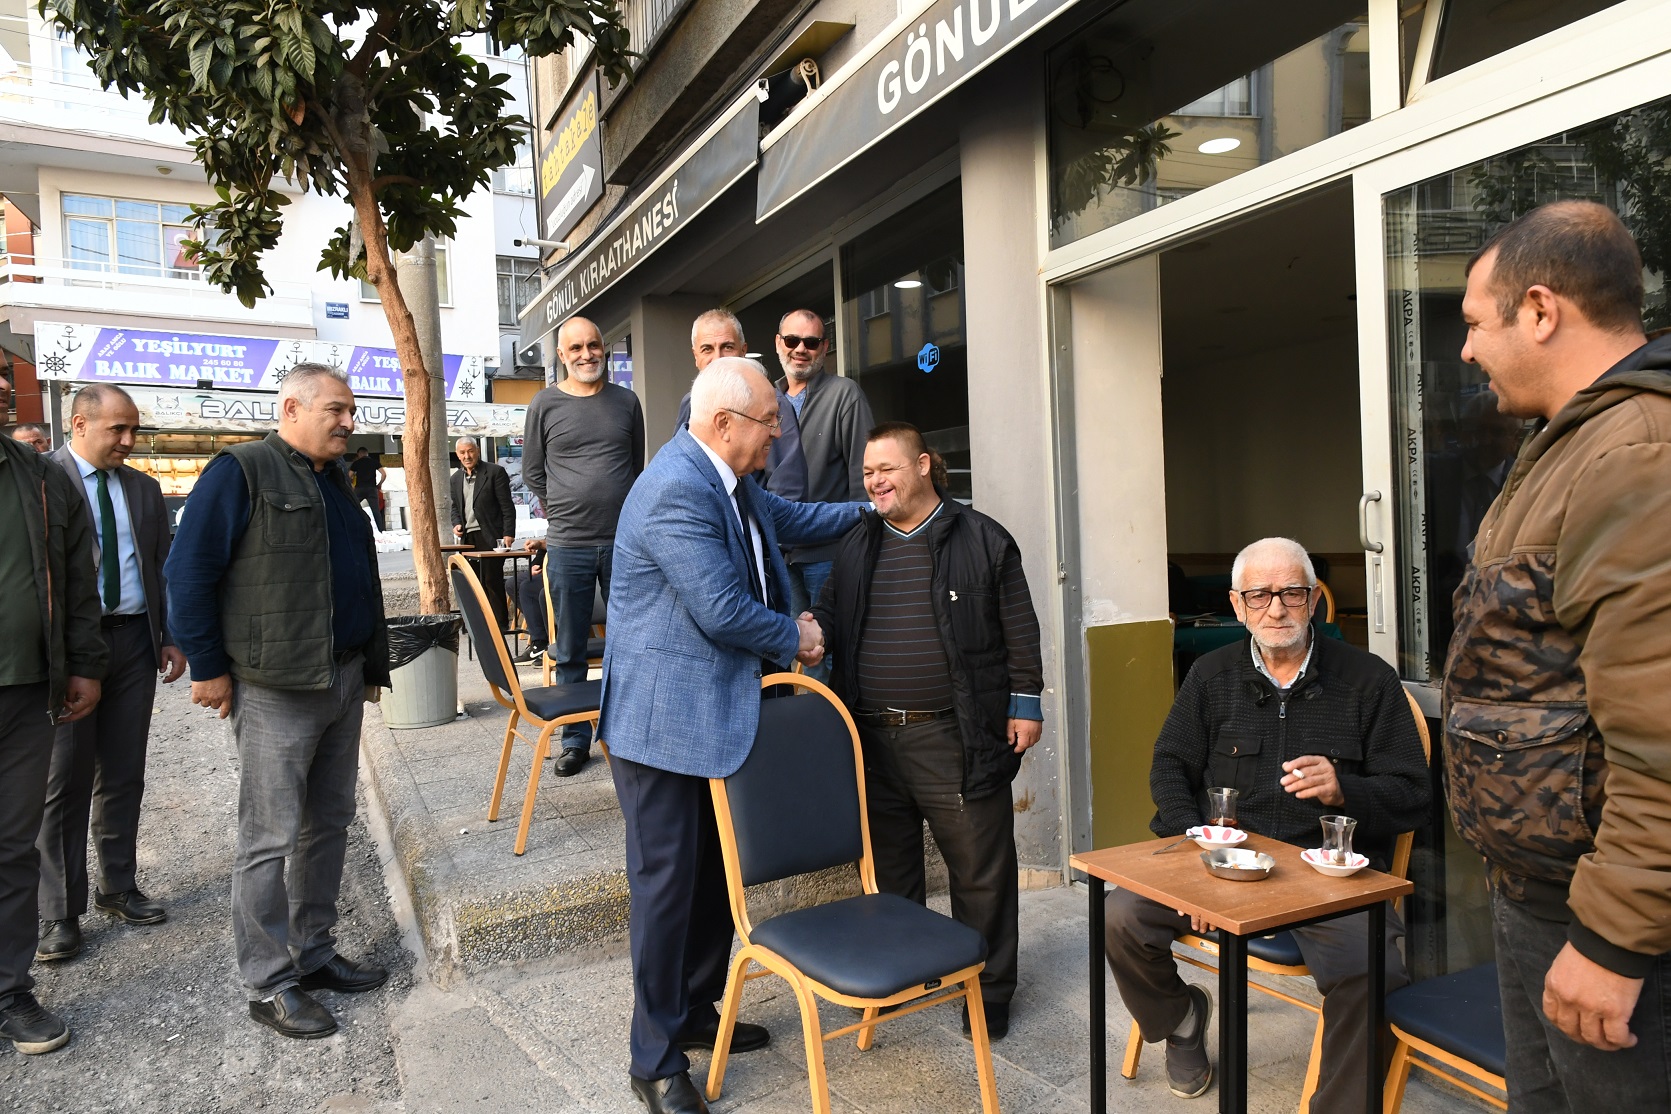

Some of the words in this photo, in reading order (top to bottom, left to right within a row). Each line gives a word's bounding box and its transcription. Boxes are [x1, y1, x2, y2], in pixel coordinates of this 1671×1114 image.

[546, 279, 578, 324] GÖNÜL
[579, 178, 679, 298] KIRAATHANESİ
[1402, 289, 1413, 327] AKPA
[131, 336, 248, 359] YEŞİLYURT
[203, 358, 219, 366] 245
[233, 359, 244, 367] 80
[95, 360, 162, 379] BALIK
[169, 364, 254, 384] MARKET
[350, 375, 392, 392] BALIK
[1407, 427, 1417, 465] AKPA
[1411, 566, 1421, 603] AKPA
